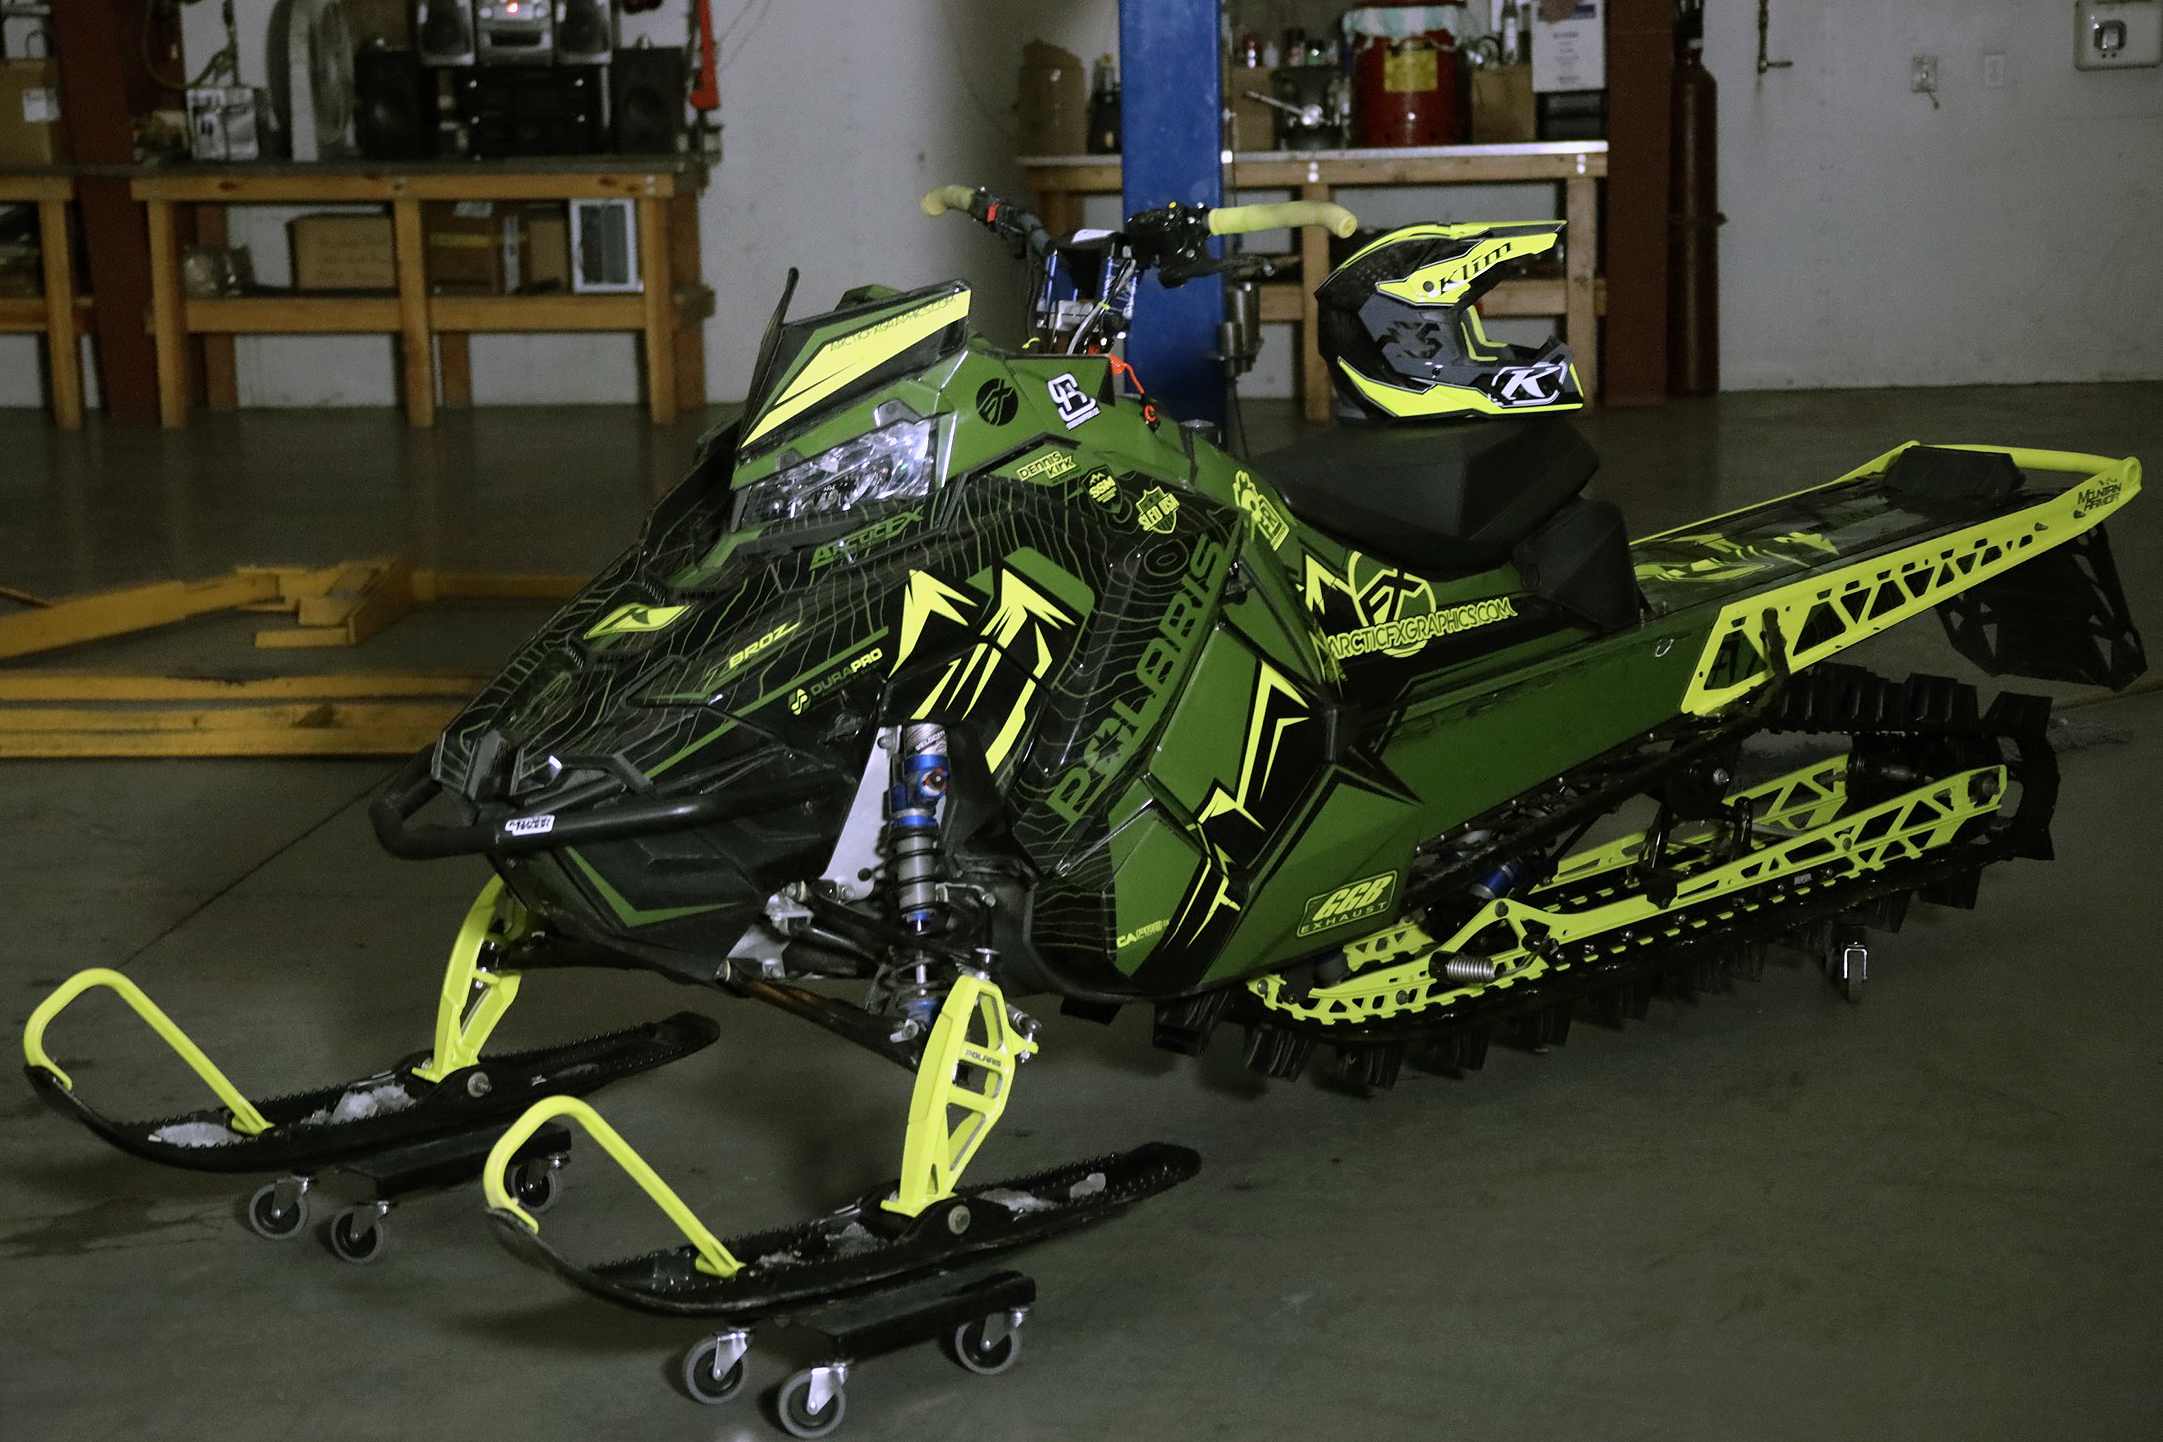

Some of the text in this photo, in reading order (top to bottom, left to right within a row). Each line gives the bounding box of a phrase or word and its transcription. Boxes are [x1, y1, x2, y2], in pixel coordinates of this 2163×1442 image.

[1088, 475, 1117, 499] SSM
[1328, 596, 1519, 661] ARCTICFXGRAPHICS.COM
[810, 648, 883, 696] DURAPRO
[1045, 533, 1225, 824] POLARIS
[1300, 901, 1388, 934] EXHAUST
